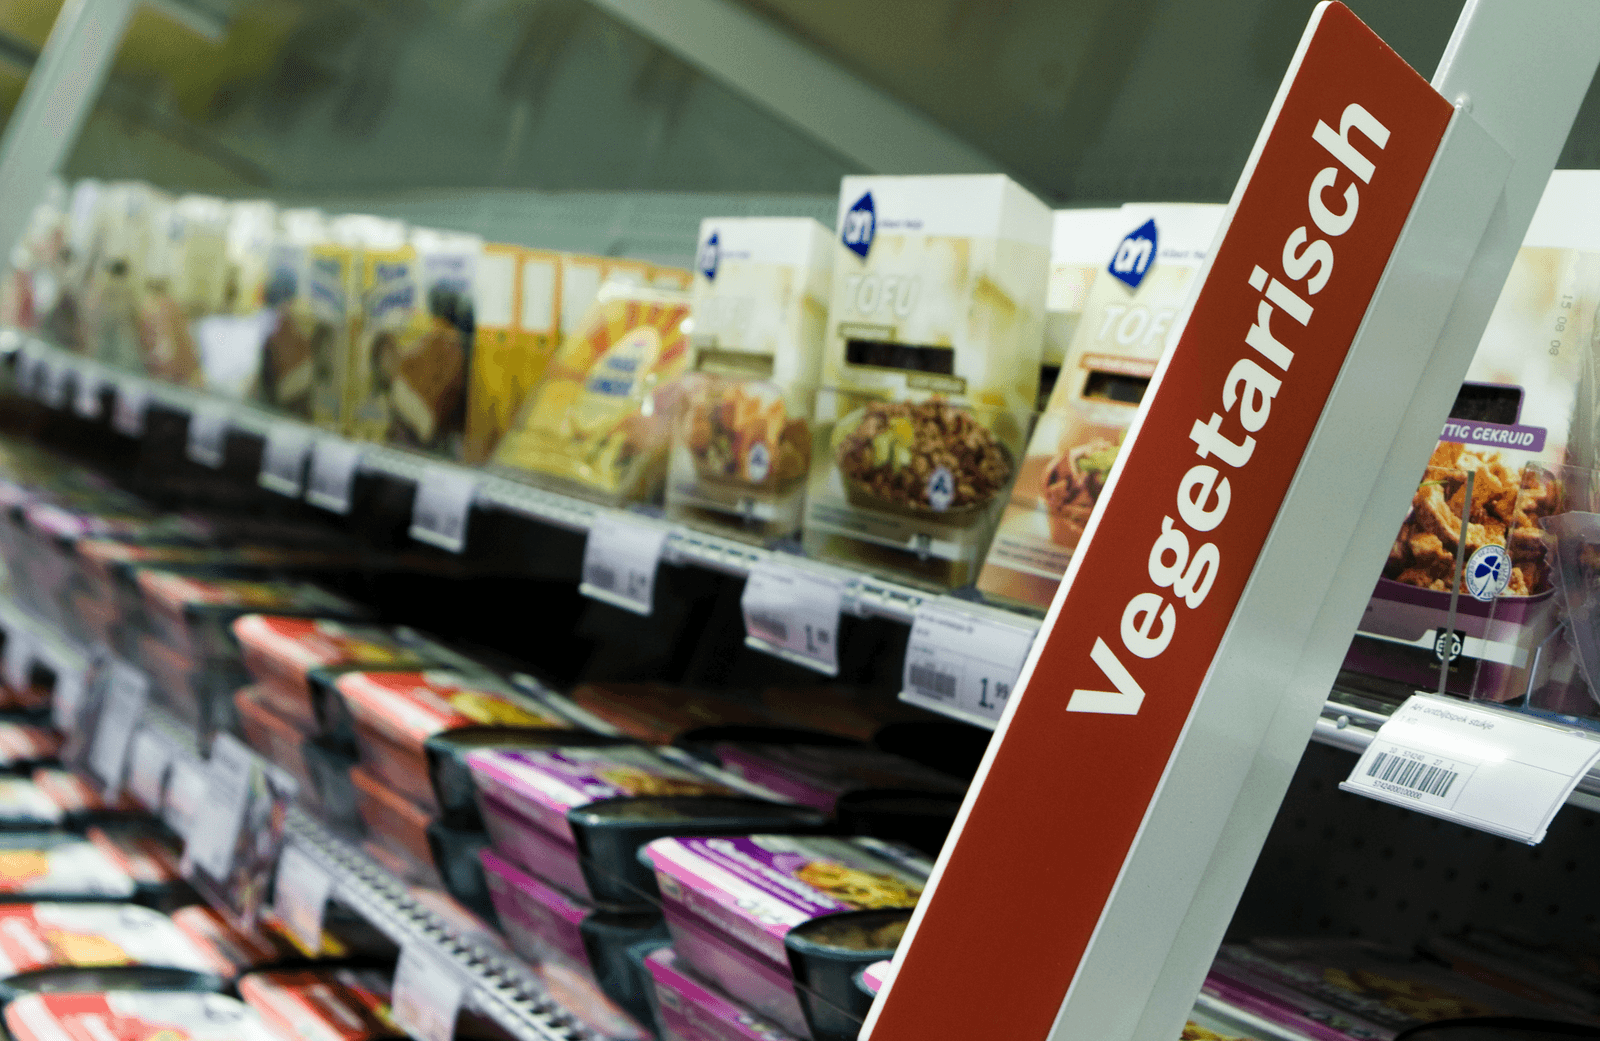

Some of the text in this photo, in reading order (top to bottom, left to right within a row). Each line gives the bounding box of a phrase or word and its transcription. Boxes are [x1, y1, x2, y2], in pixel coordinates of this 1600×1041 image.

[1100, 307, 1176, 346] TOF
[1065, 102, 1391, 716] Vegetarisch
[1441, 423, 1534, 446] TTIG GEKRUID
[1436, 639, 1461, 656] EO
[1468, 719, 1495, 730] stukje
